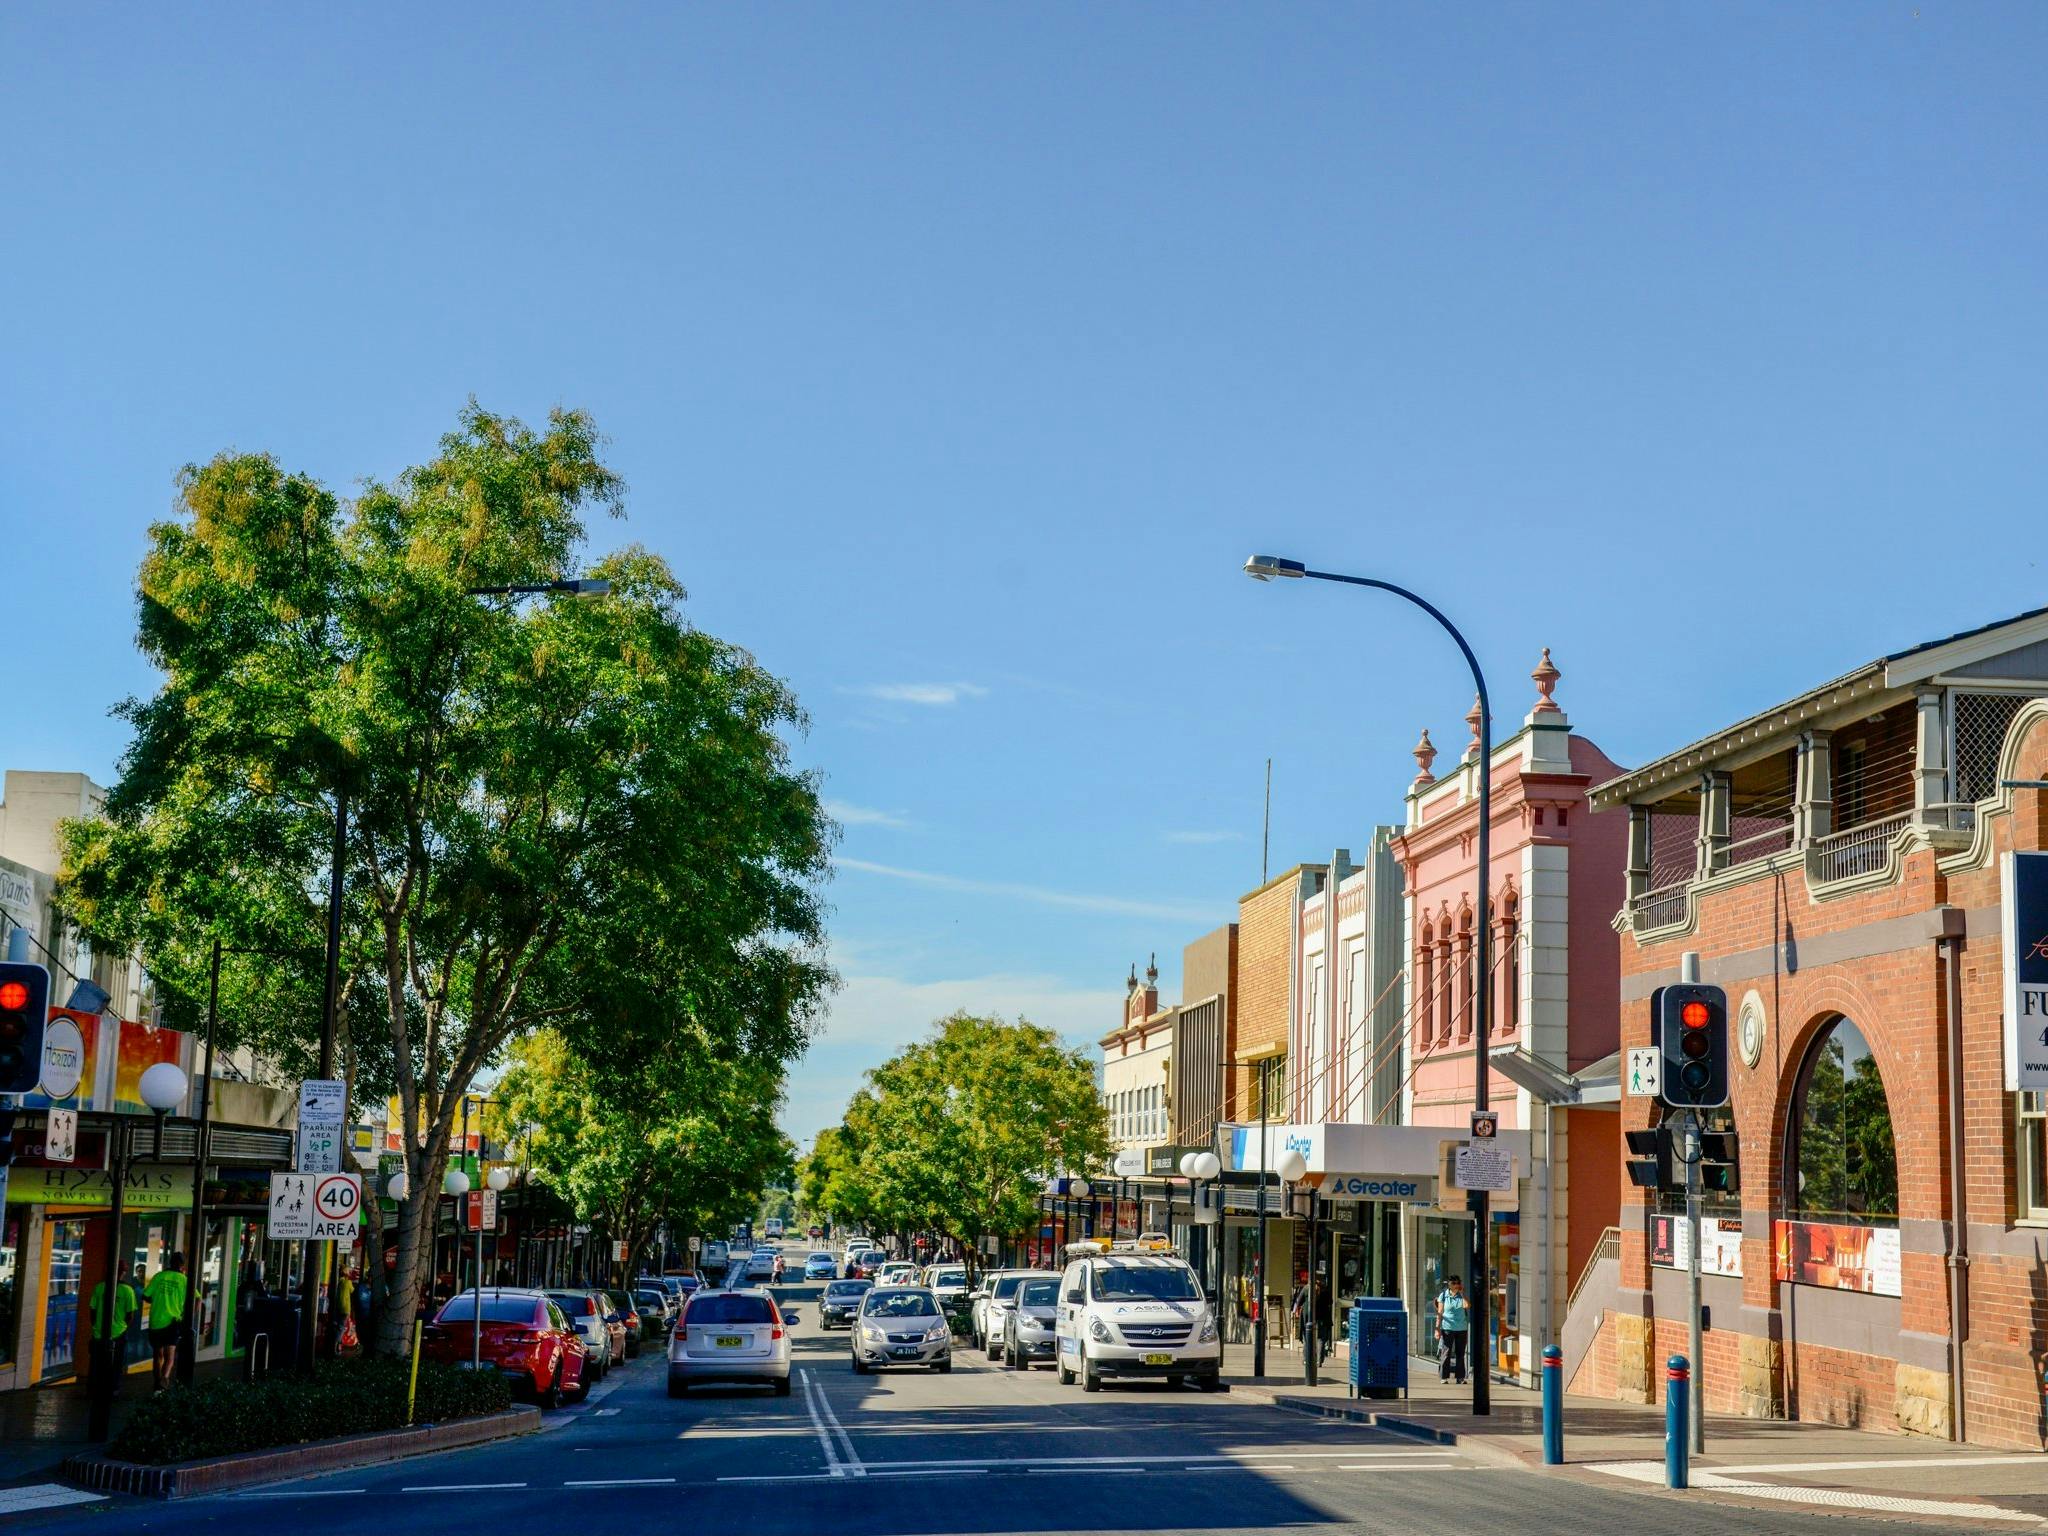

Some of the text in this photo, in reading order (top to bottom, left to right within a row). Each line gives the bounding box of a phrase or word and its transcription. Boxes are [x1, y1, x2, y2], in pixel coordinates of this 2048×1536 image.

[1348, 1178, 1418, 1196] Greater
[43, 1191, 97, 1201] NOWRA
[322, 1188, 354, 1208] 40
[314, 1223, 358, 1236] AREA
[1134, 1304, 1195, 1313] ASSURED
